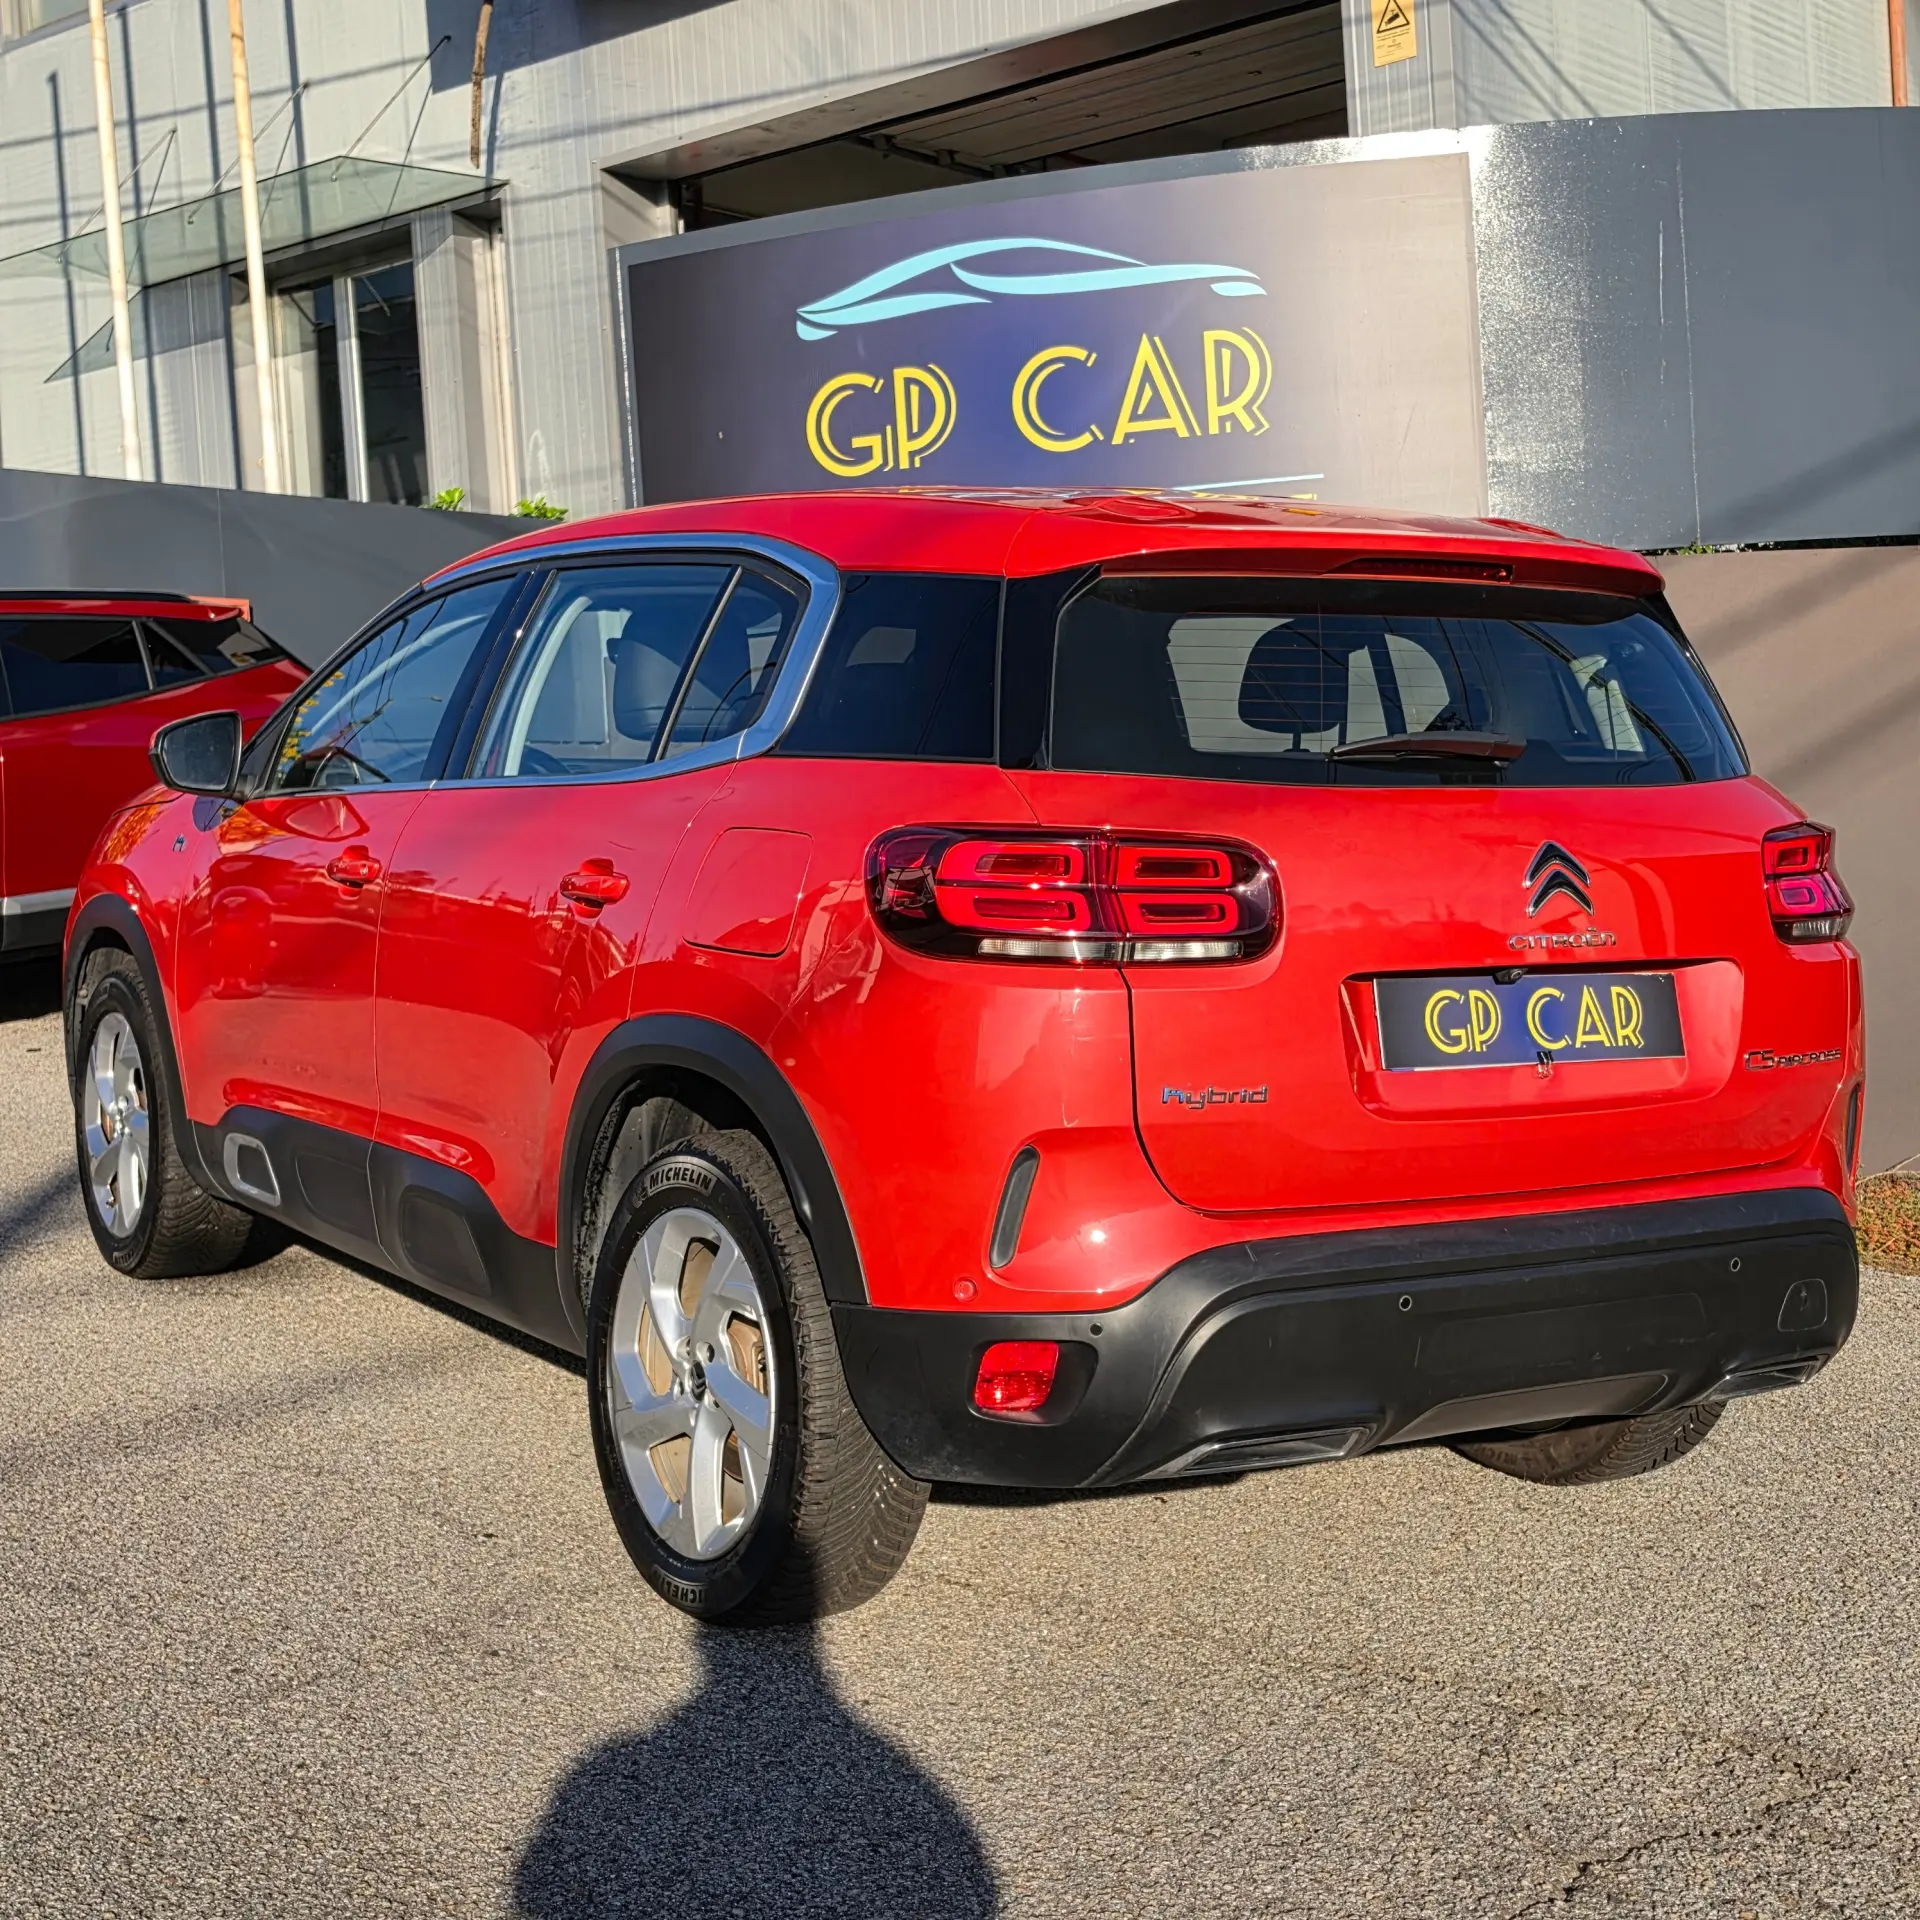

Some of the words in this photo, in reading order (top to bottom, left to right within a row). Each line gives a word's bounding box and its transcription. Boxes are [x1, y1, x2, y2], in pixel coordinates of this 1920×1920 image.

[806, 363, 957, 476] GP
[1011, 326, 1273, 452] CAR
[1424, 989, 1501, 1054] GP
[1526, 984, 1645, 1051] CAR
[1744, 1048, 1775, 1071] C5
[649, 1166, 712, 1190] MICHELIN
